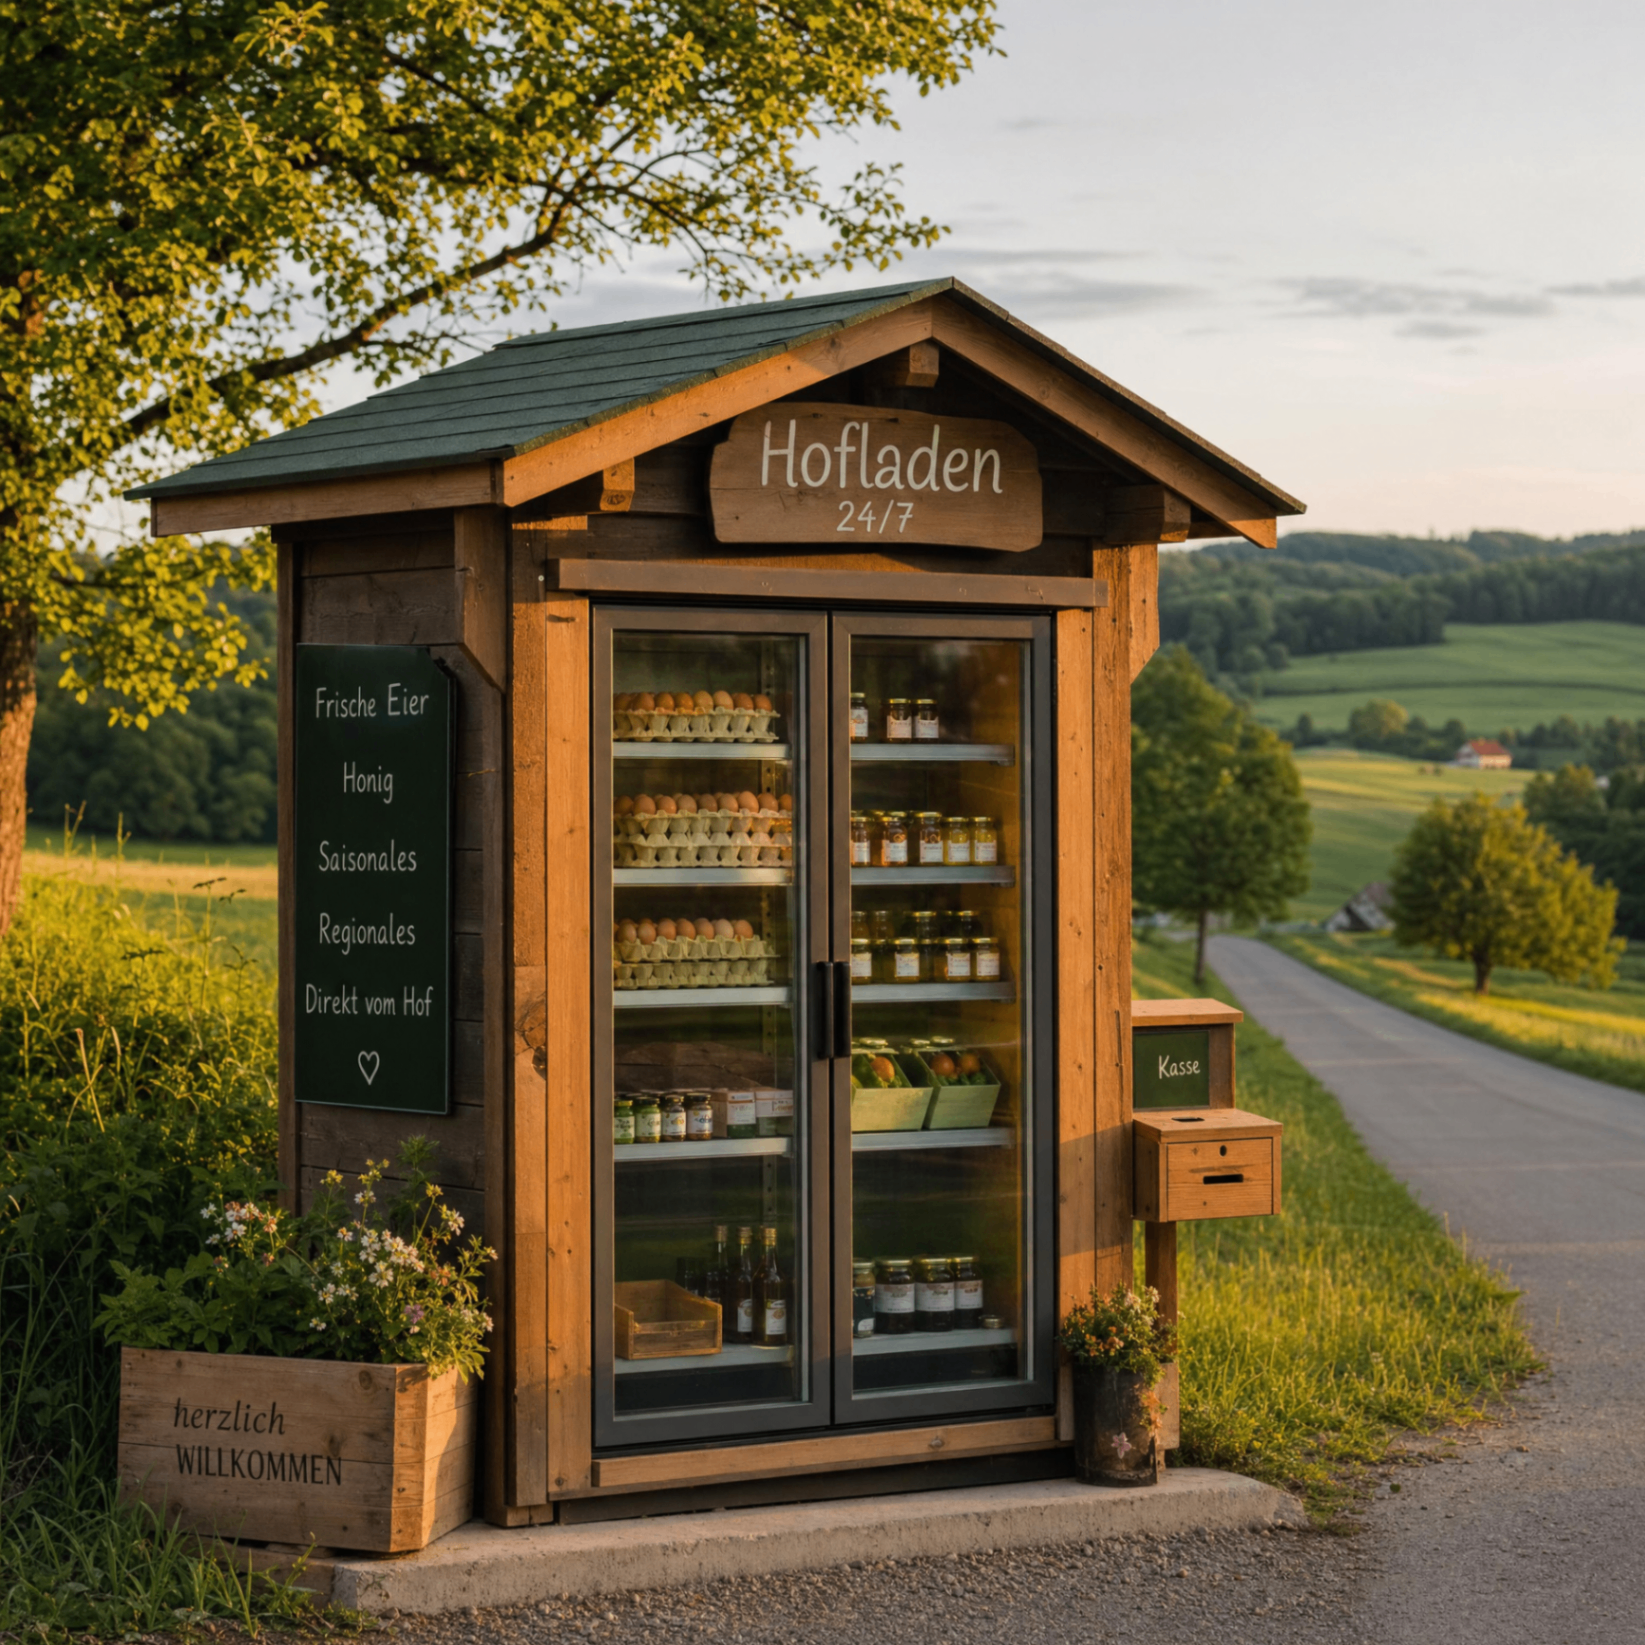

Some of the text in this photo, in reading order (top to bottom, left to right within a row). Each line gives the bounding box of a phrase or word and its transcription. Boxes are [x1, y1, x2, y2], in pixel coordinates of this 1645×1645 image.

[761, 419, 1003, 493] Hofladen
[836, 499, 914, 534] 24/7
[316, 683, 429, 719] Frische Eier
[343, 761, 394, 804] Honig
[318, 839, 417, 872] Saisonales
[319, 912, 416, 955] Regionales
[305, 983, 434, 1017] Direkt vom Hof
[1158, 1054, 1201, 1080] Kasse
[173, 1397, 286, 1436] herzlich
[176, 1444, 342, 1486] WILLKOMMEN
